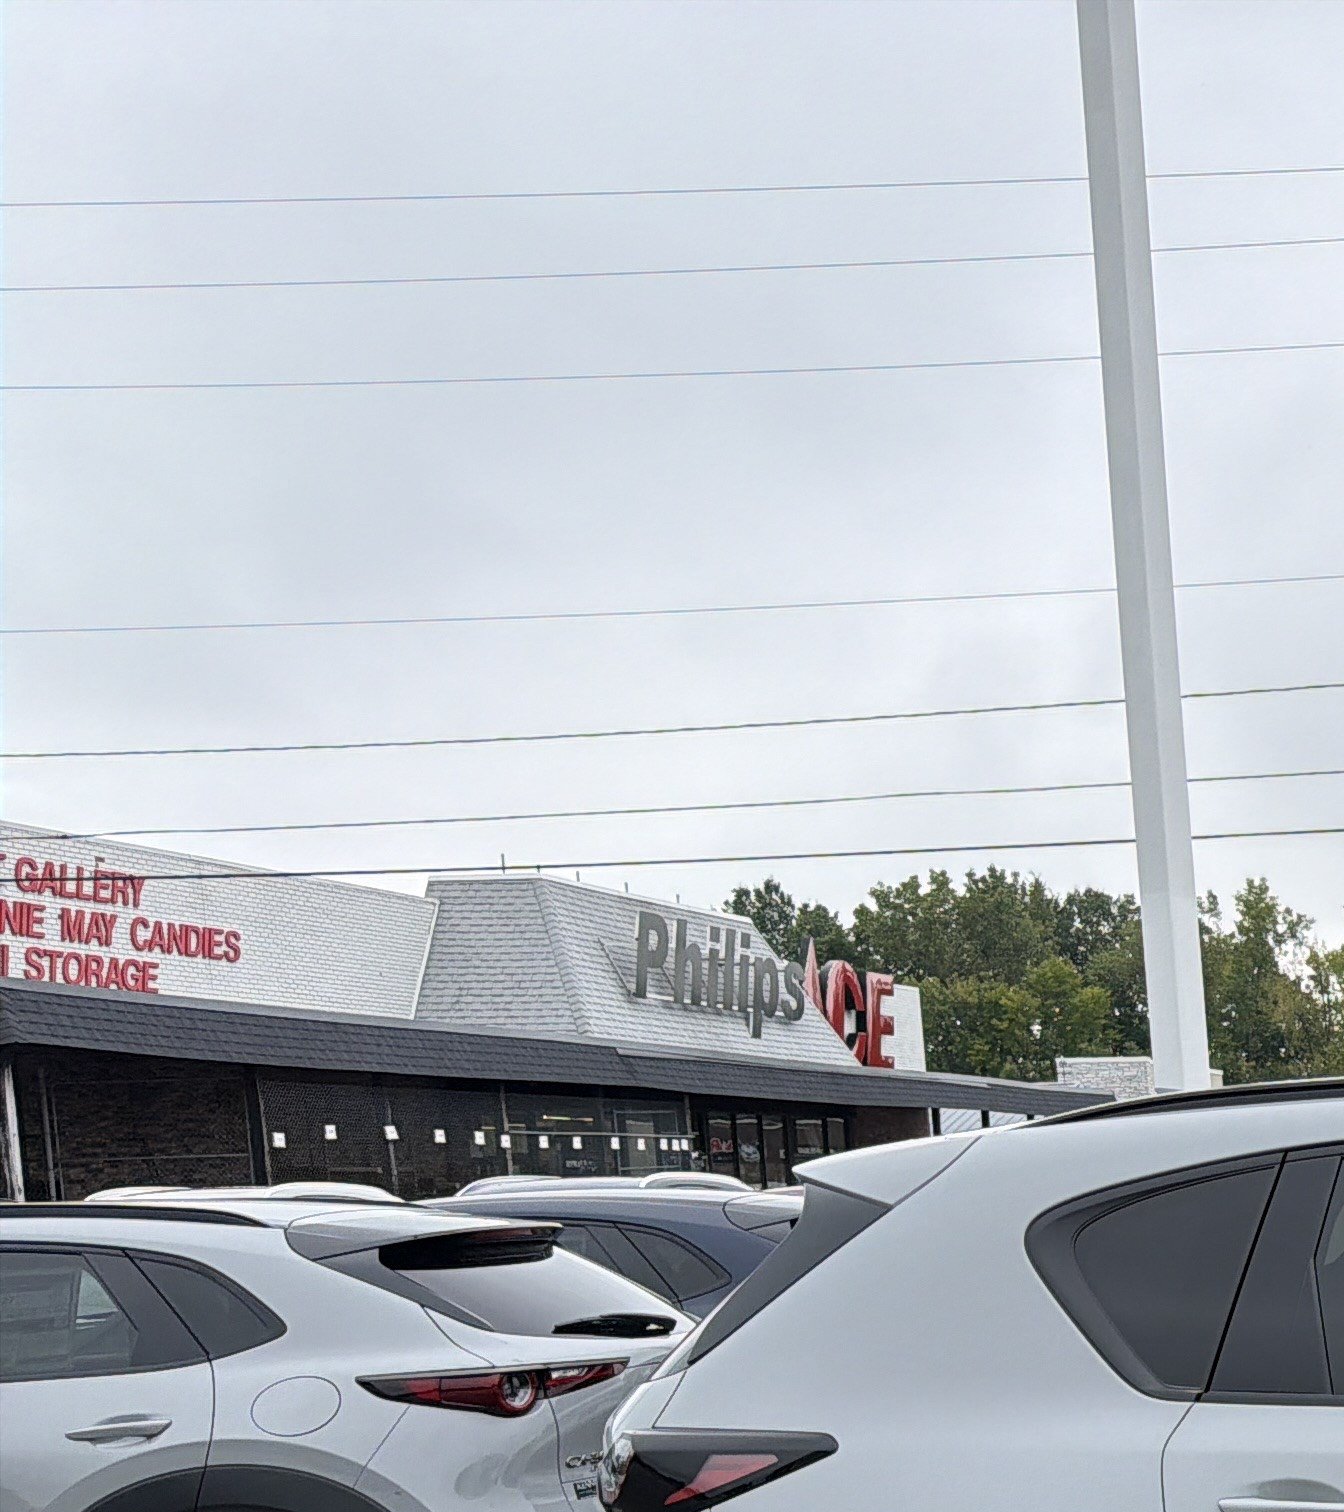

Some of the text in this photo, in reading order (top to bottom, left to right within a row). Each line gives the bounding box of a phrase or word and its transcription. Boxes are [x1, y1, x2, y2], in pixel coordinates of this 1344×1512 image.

[15, 857, 145, 908] GALLERY
[59, 908, 118, 946] MAY
[130, 917, 242, 963] CANDIES
[24, 946, 160, 994] STORAGE
[633, 911, 805, 1039] Philips
